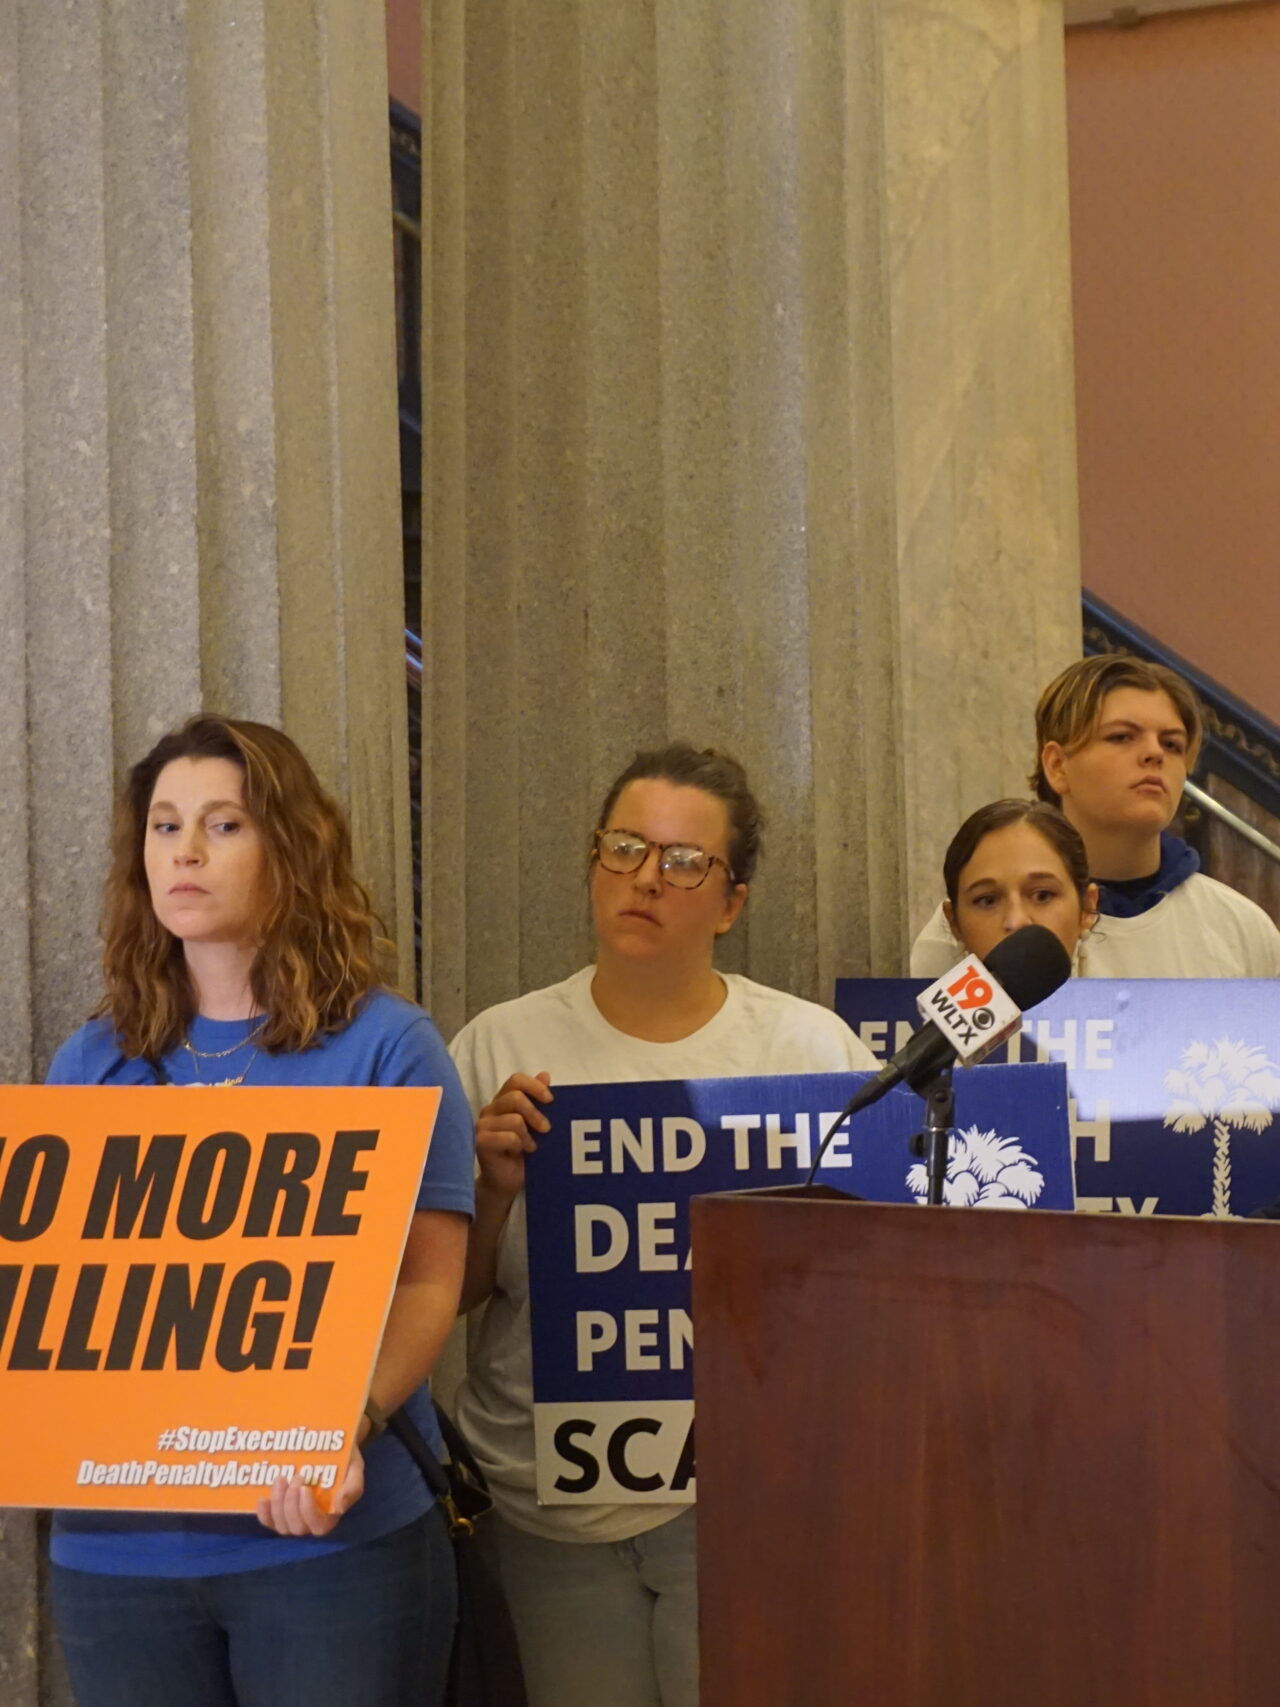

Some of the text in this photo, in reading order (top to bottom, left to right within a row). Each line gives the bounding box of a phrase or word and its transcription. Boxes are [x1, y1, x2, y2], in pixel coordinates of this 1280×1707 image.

[946, 965, 993, 1010] 19
[931, 989, 978, 1046] WLTX
[570, 1111, 853, 1175] END THE
[0, 1129, 381, 1243] O MORE
[574, 1202, 692, 1274] DE
[157, 1426, 345, 1454] #StopExecutions
[76, 1459, 338, 1489] DeathPenaltyActionorg
